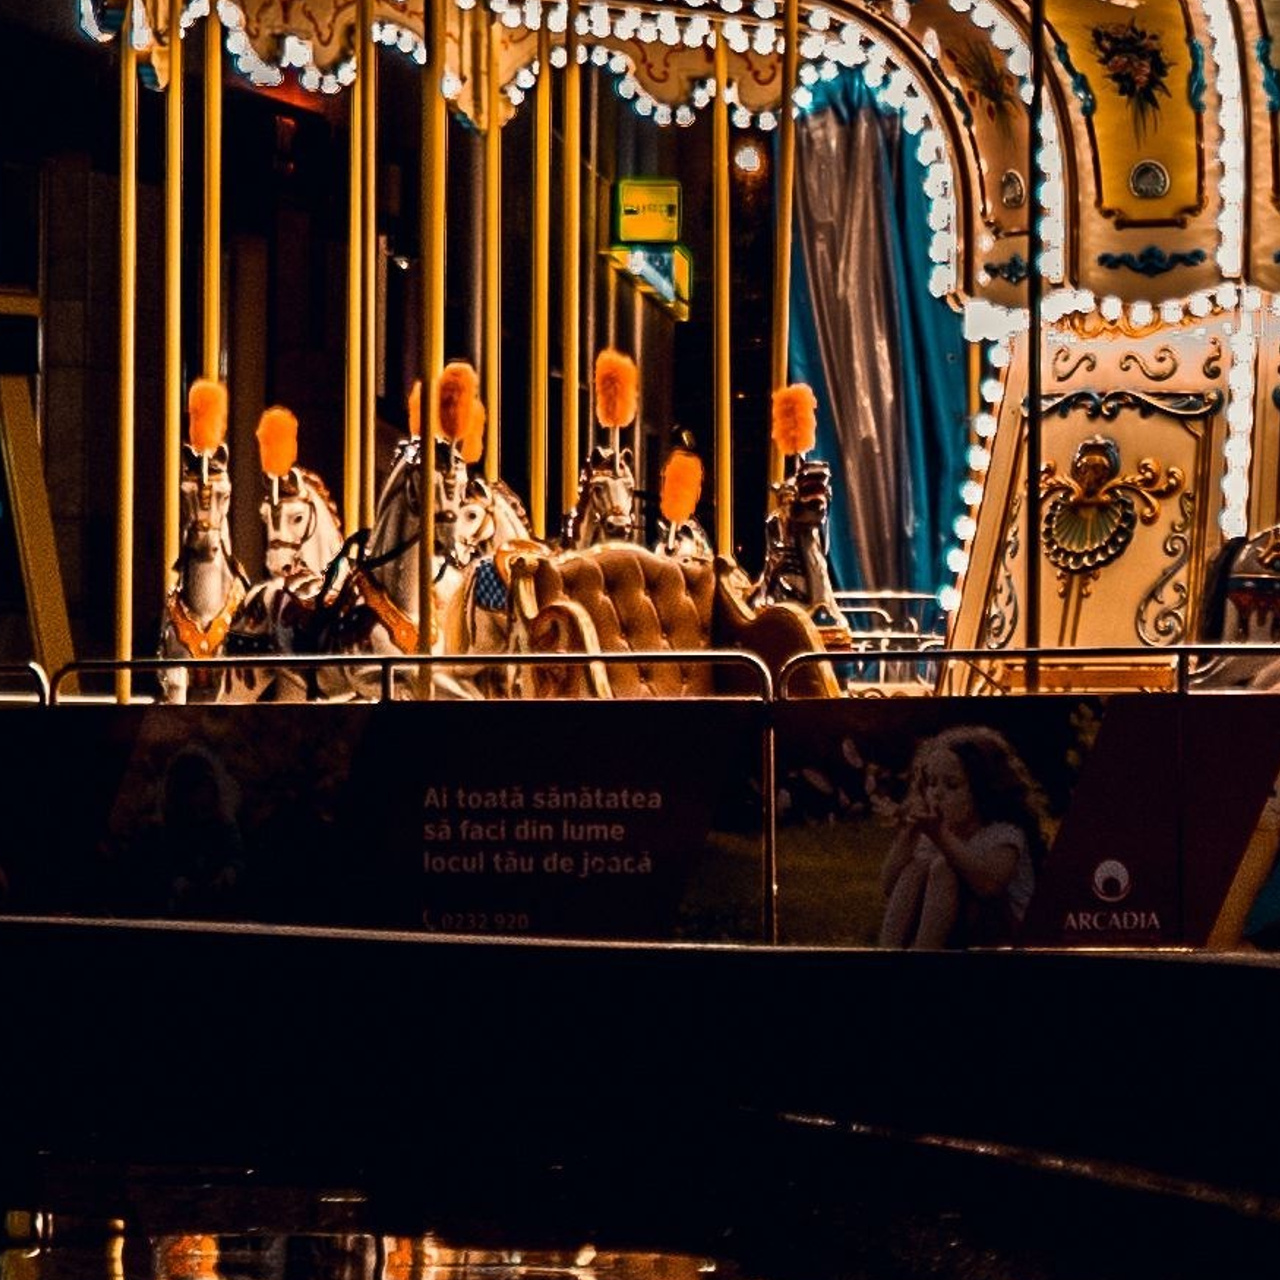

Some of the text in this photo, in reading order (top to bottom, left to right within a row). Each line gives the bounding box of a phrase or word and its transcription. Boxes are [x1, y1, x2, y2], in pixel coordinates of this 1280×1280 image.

[423, 784, 663, 809] Ai toată sănătatea
[423, 818, 627, 841] să faci din lume
[423, 851, 484, 874] locul
[493, 851, 534, 874] tău
[542, 852, 575, 874] de
[1064, 910, 1161, 931] ARCADIA
